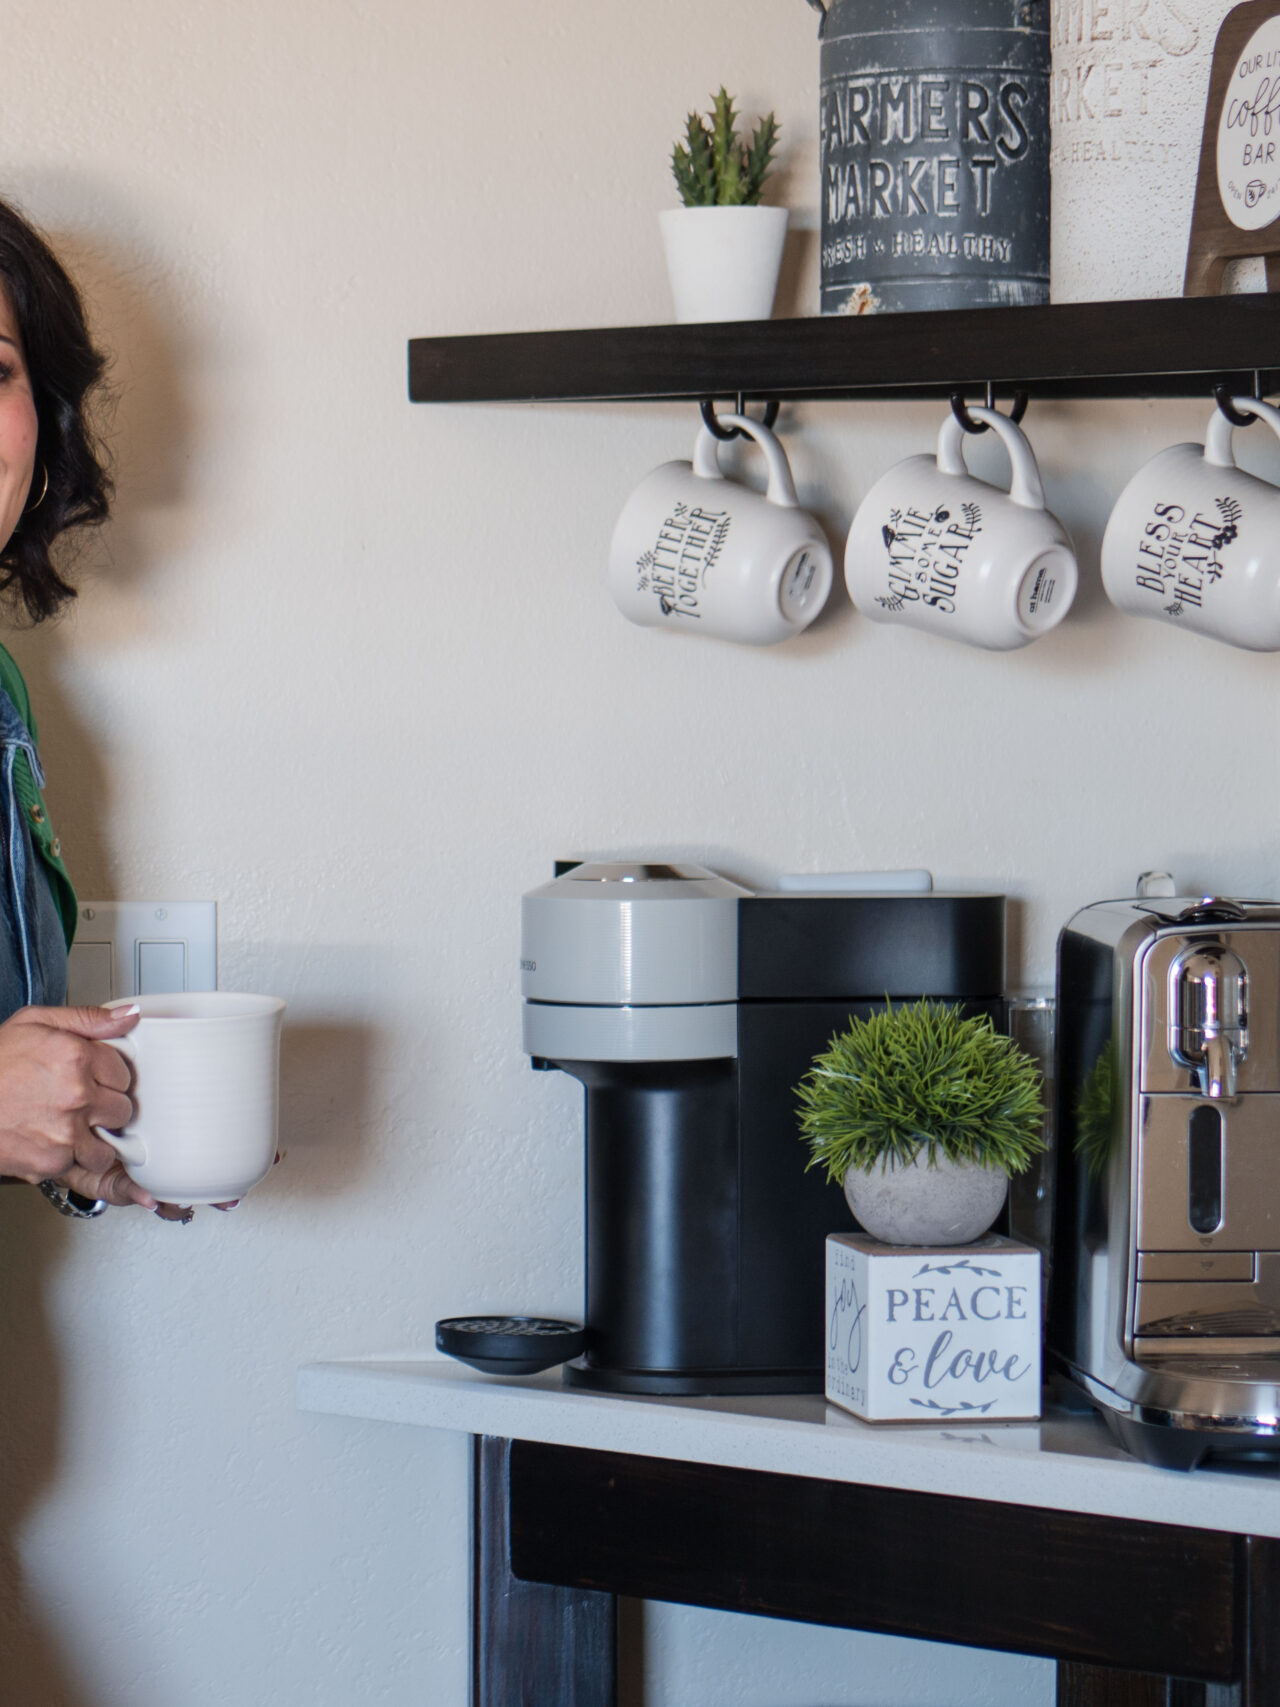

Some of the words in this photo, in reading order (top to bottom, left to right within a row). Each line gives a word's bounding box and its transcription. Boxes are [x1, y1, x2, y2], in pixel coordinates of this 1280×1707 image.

[1239, 54, 1263, 79] OUR
[1266, 50, 1280, 68] LI
[1227, 77, 1280, 137] coff
[1242, 142, 1276, 166] BAR
[827, 156, 997, 224] MARKET
[892, 229, 1012, 263] HEALTHY
[652, 517, 692, 600] BETTER
[673, 507, 727, 618] TOGETHER
[888, 507, 933, 602] GIMMIE
[914, 527, 943, 584] SOME
[922, 523, 982, 614] SUGAR
[1136, 503, 1186, 595] BLESS
[1162, 531, 1189, 579] YOUR
[1174, 512, 1221, 608] HEART
[834, 1249, 856, 1272] find
[830, 1275, 867, 1374] joy
[885, 1285, 1028, 1322] PEACE
[887, 1347, 919, 1385] &
[923, 1330, 1032, 1389] love
